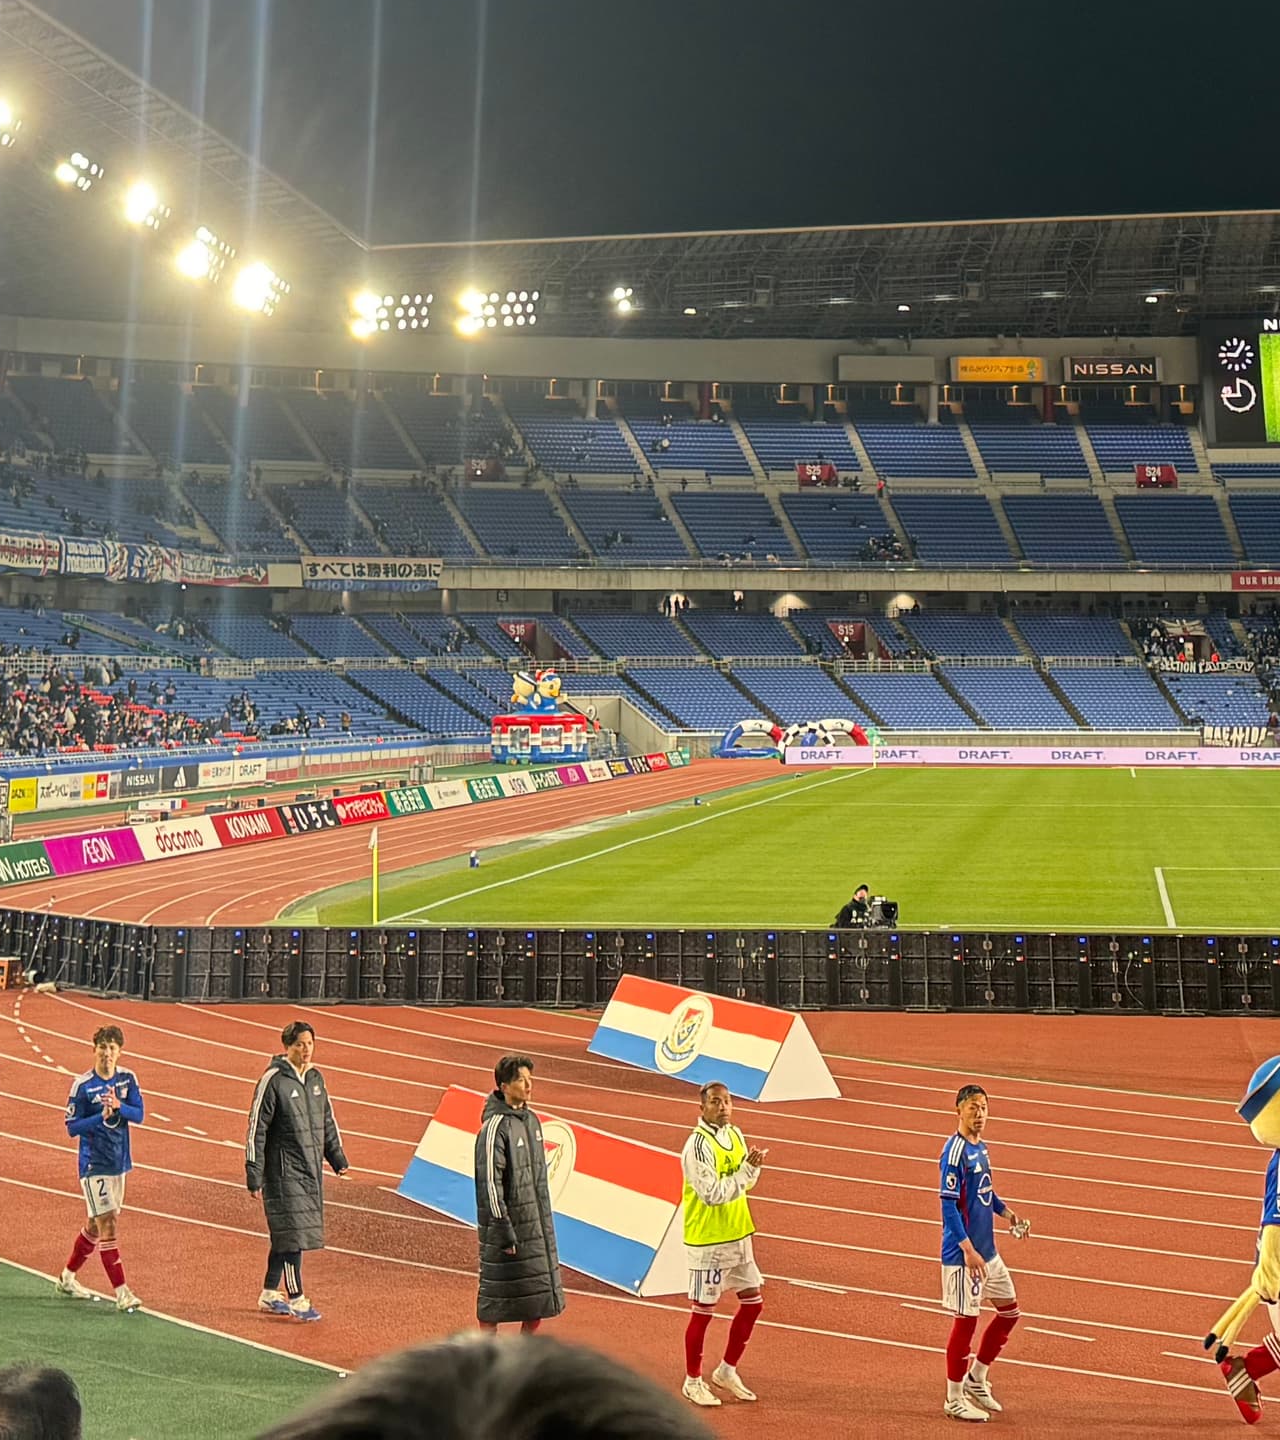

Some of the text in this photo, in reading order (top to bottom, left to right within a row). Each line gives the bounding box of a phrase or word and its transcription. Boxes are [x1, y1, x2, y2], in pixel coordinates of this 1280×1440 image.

[1073, 363, 1154, 375] NISSAN
[805, 465, 821, 476] S25
[1145, 466, 1162, 477] S24
[1239, 575, 1258, 586] OUR
[509, 624, 525, 635] S16
[837, 624, 855, 636] S15
[126, 773, 155, 787] NISSAN
[228, 812, 271, 839] KONAMI
[156, 826, 203, 853] docomo
[13, 856, 50, 879] HOTELS
[97, 1178, 107, 1197] 2
[704, 1268, 722, 1285] 18
[971, 1276, 980, 1297] 8
